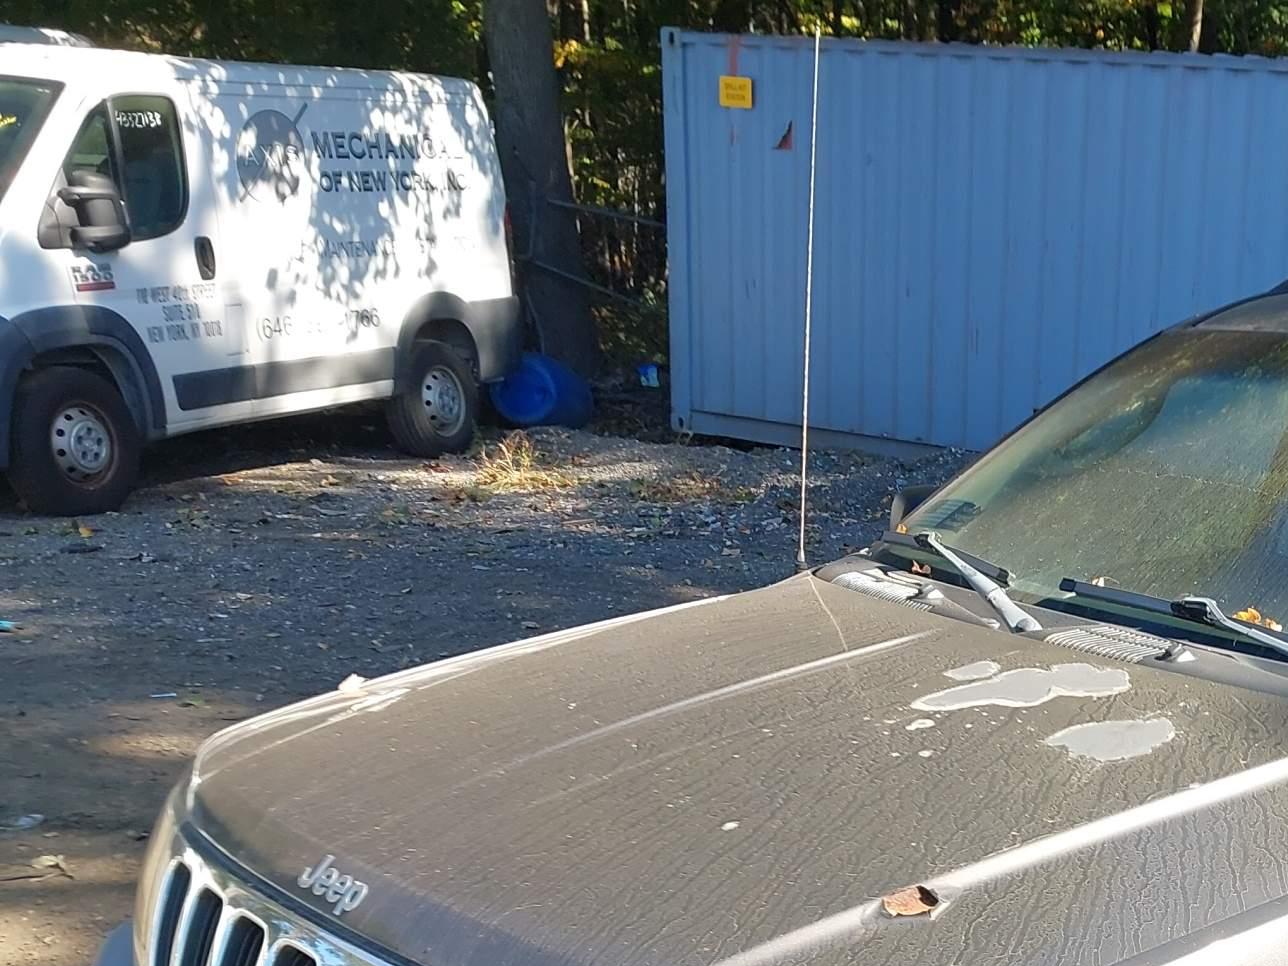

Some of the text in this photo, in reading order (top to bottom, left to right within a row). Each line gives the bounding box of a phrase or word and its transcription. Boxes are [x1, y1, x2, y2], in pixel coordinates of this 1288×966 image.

[320, 169, 343, 193] OF
[350, 171, 387, 193] NEW
[296, 854, 369, 916] Jeep
